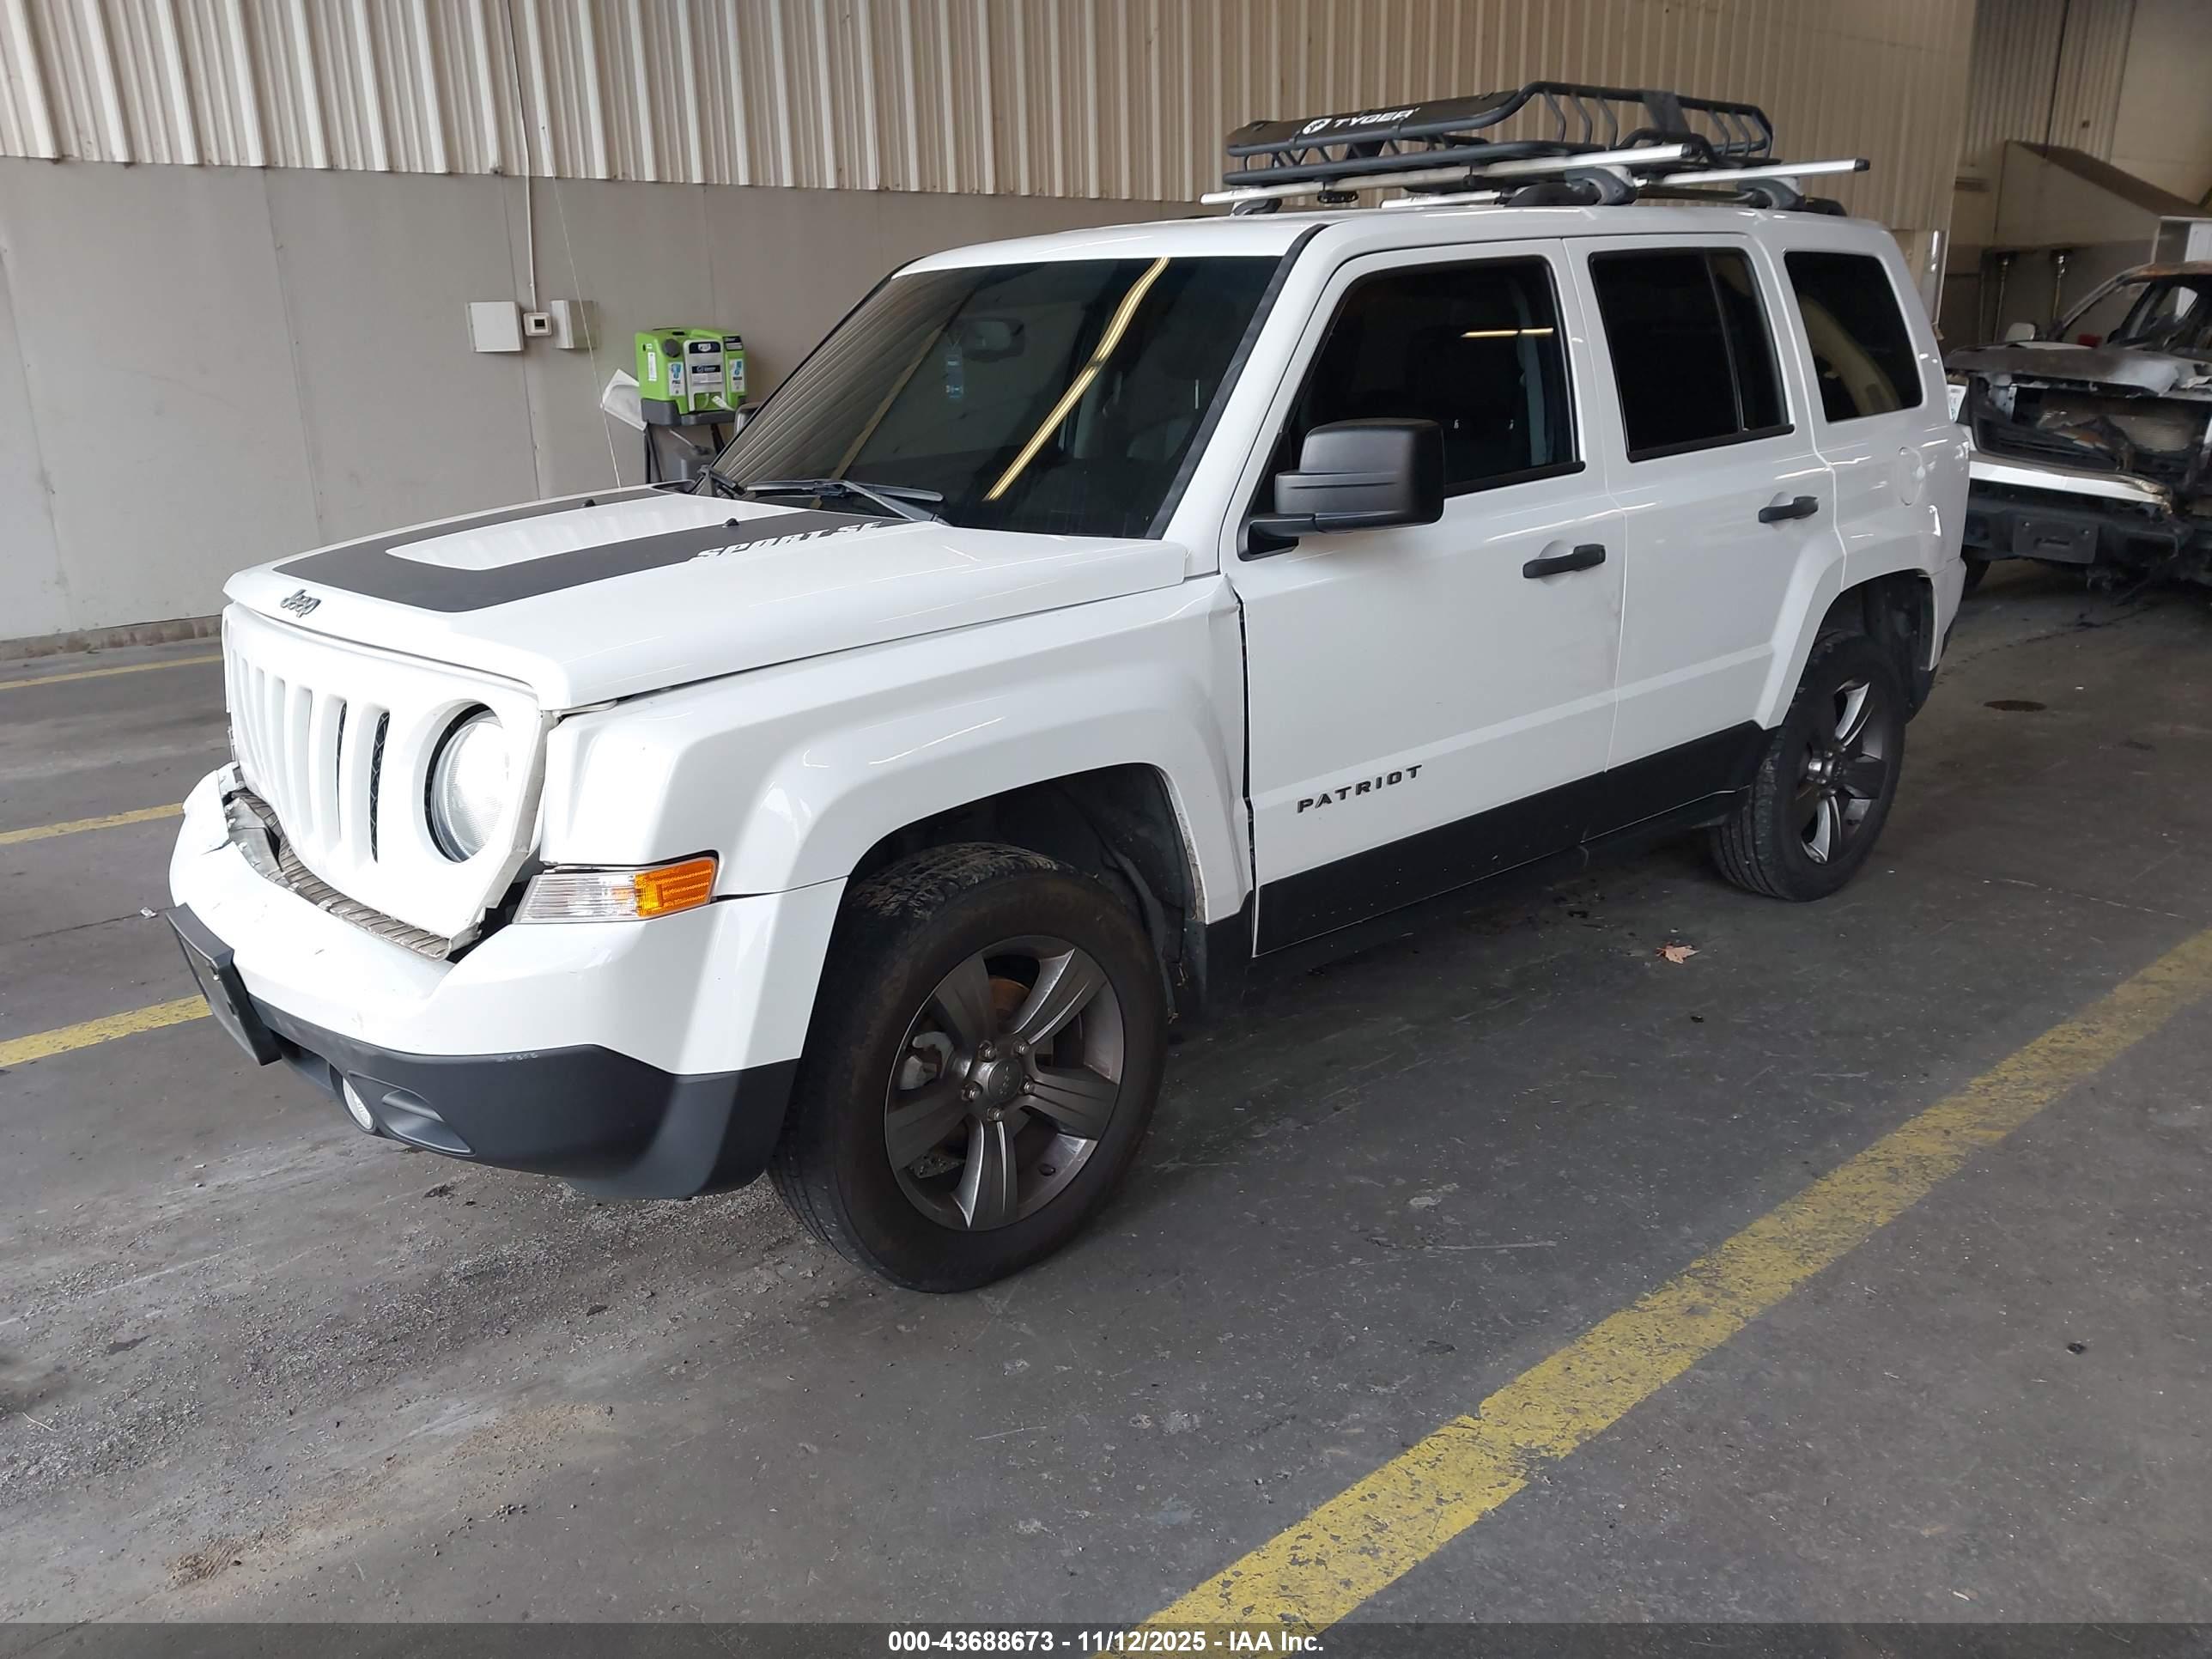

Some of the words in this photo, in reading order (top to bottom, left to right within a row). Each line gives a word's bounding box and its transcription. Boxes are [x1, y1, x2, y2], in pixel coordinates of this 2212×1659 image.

[1334, 109, 1415, 128] TYGER
[696, 529, 830, 559] SPORT
[280, 589, 322, 618] Jeep
[1297, 764, 1422, 813] PATRIOT
